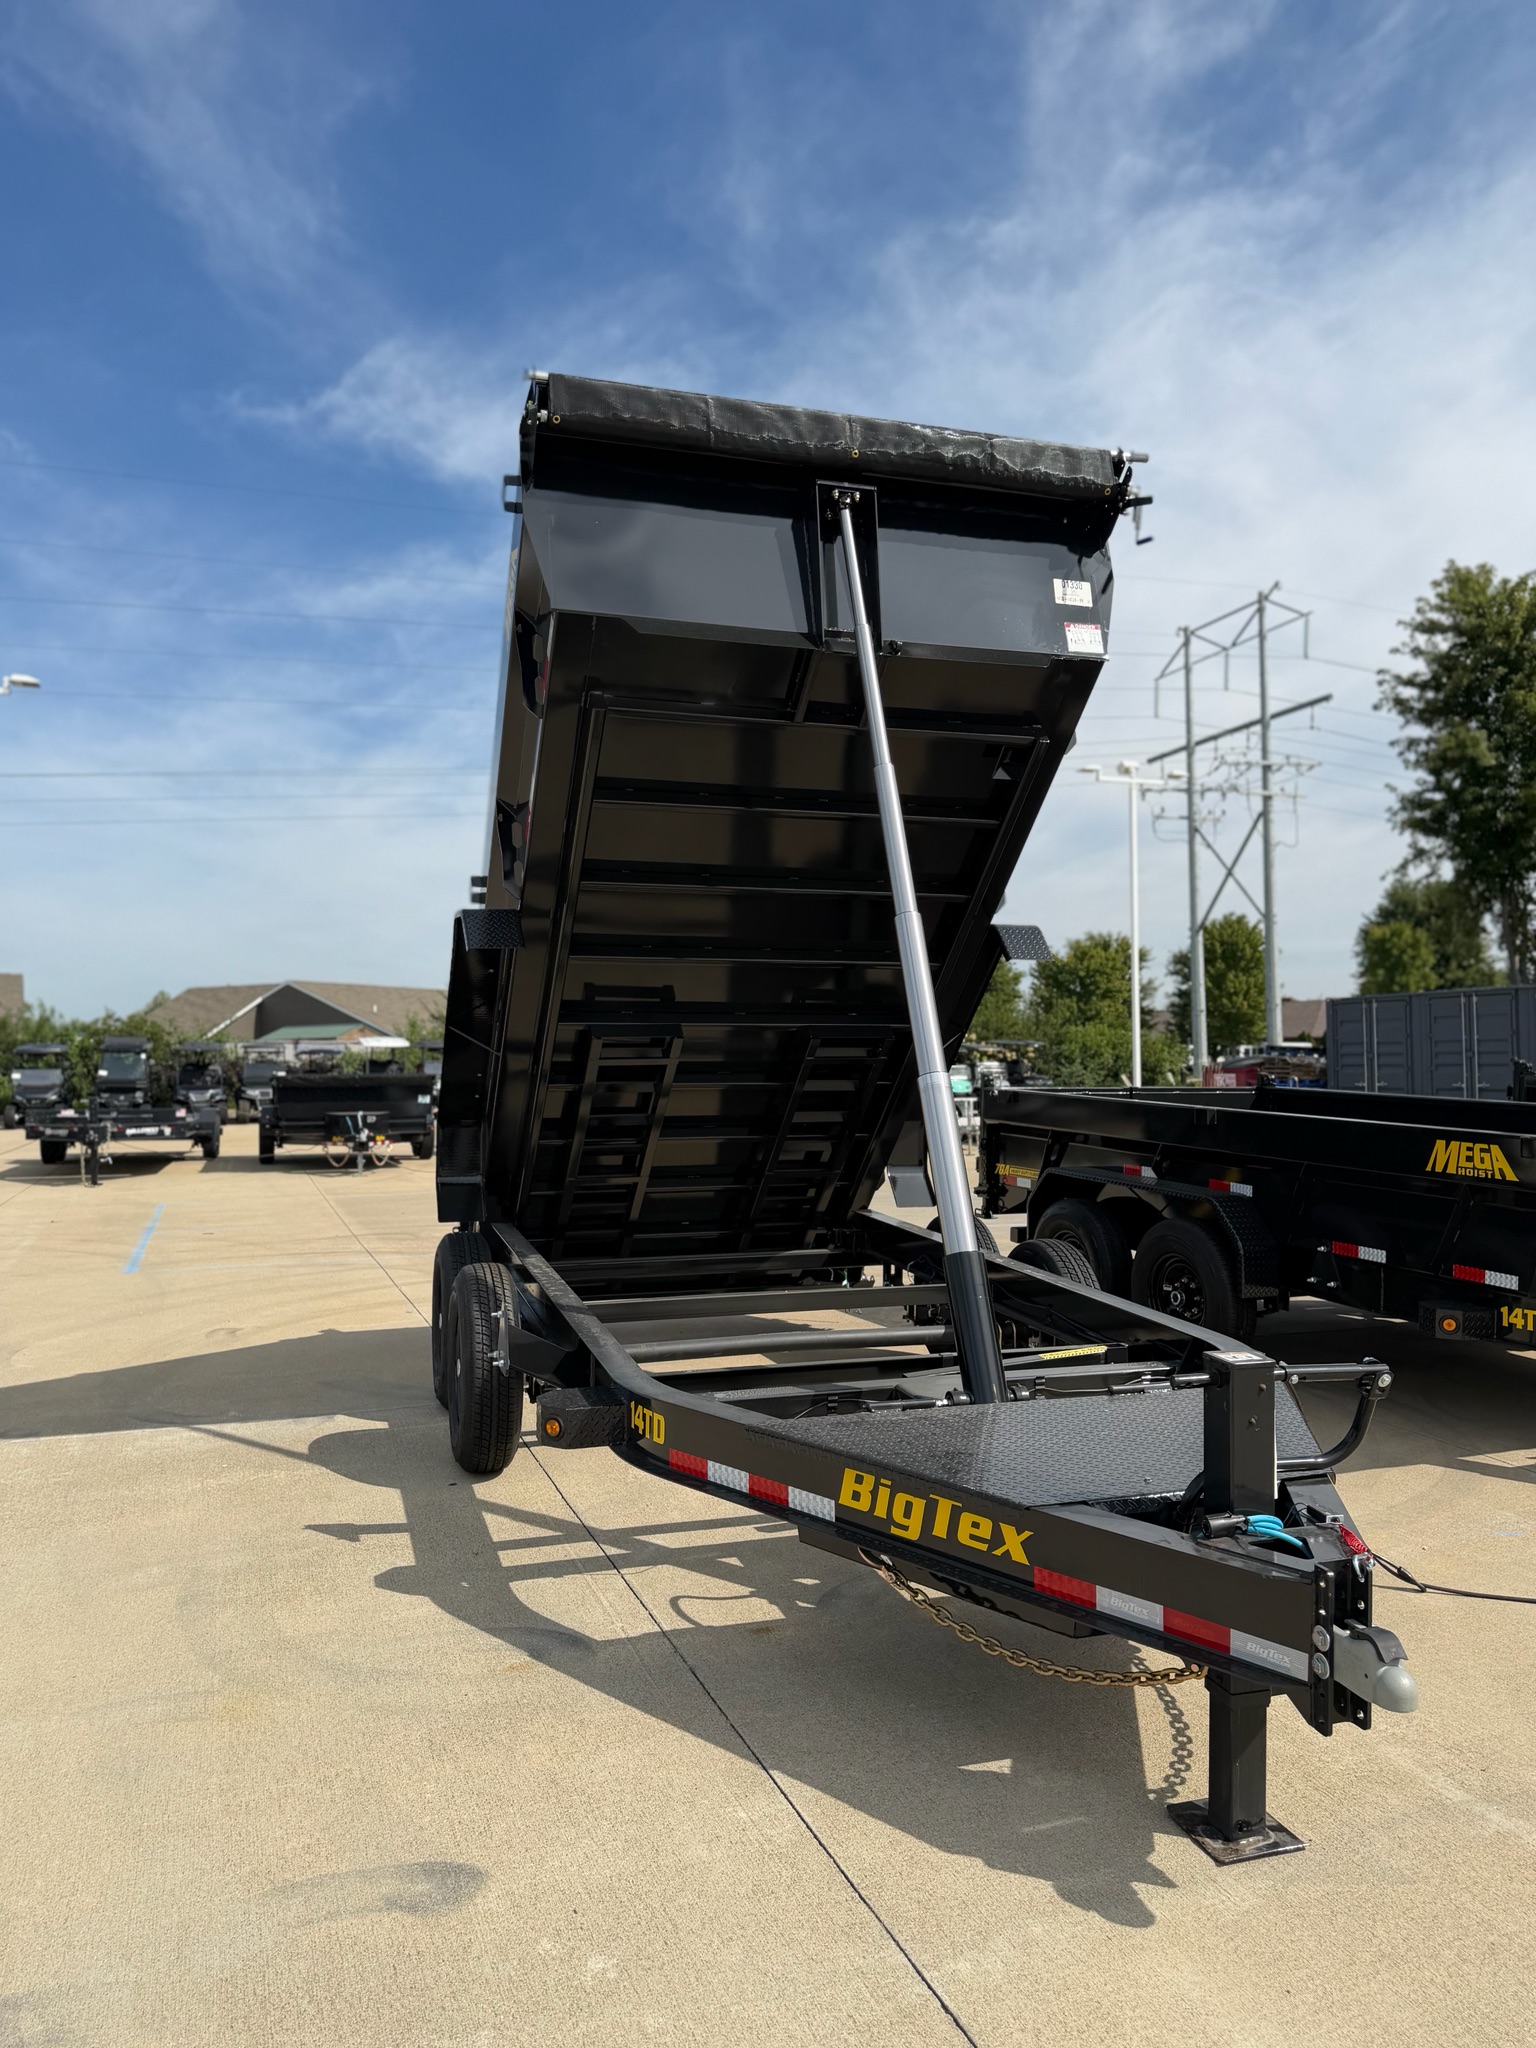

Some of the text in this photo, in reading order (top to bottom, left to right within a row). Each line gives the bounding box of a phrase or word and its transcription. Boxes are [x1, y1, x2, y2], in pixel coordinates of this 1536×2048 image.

[1425, 1139, 1520, 1182] MEGA
[1458, 1167, 1494, 1179] HOIST
[630, 1400, 665, 1445] 14TD
[838, 1467, 1035, 1566] BigTex
[1110, 1597, 1149, 1616] BigTex
[1246, 1642, 1292, 1664] BigTex
